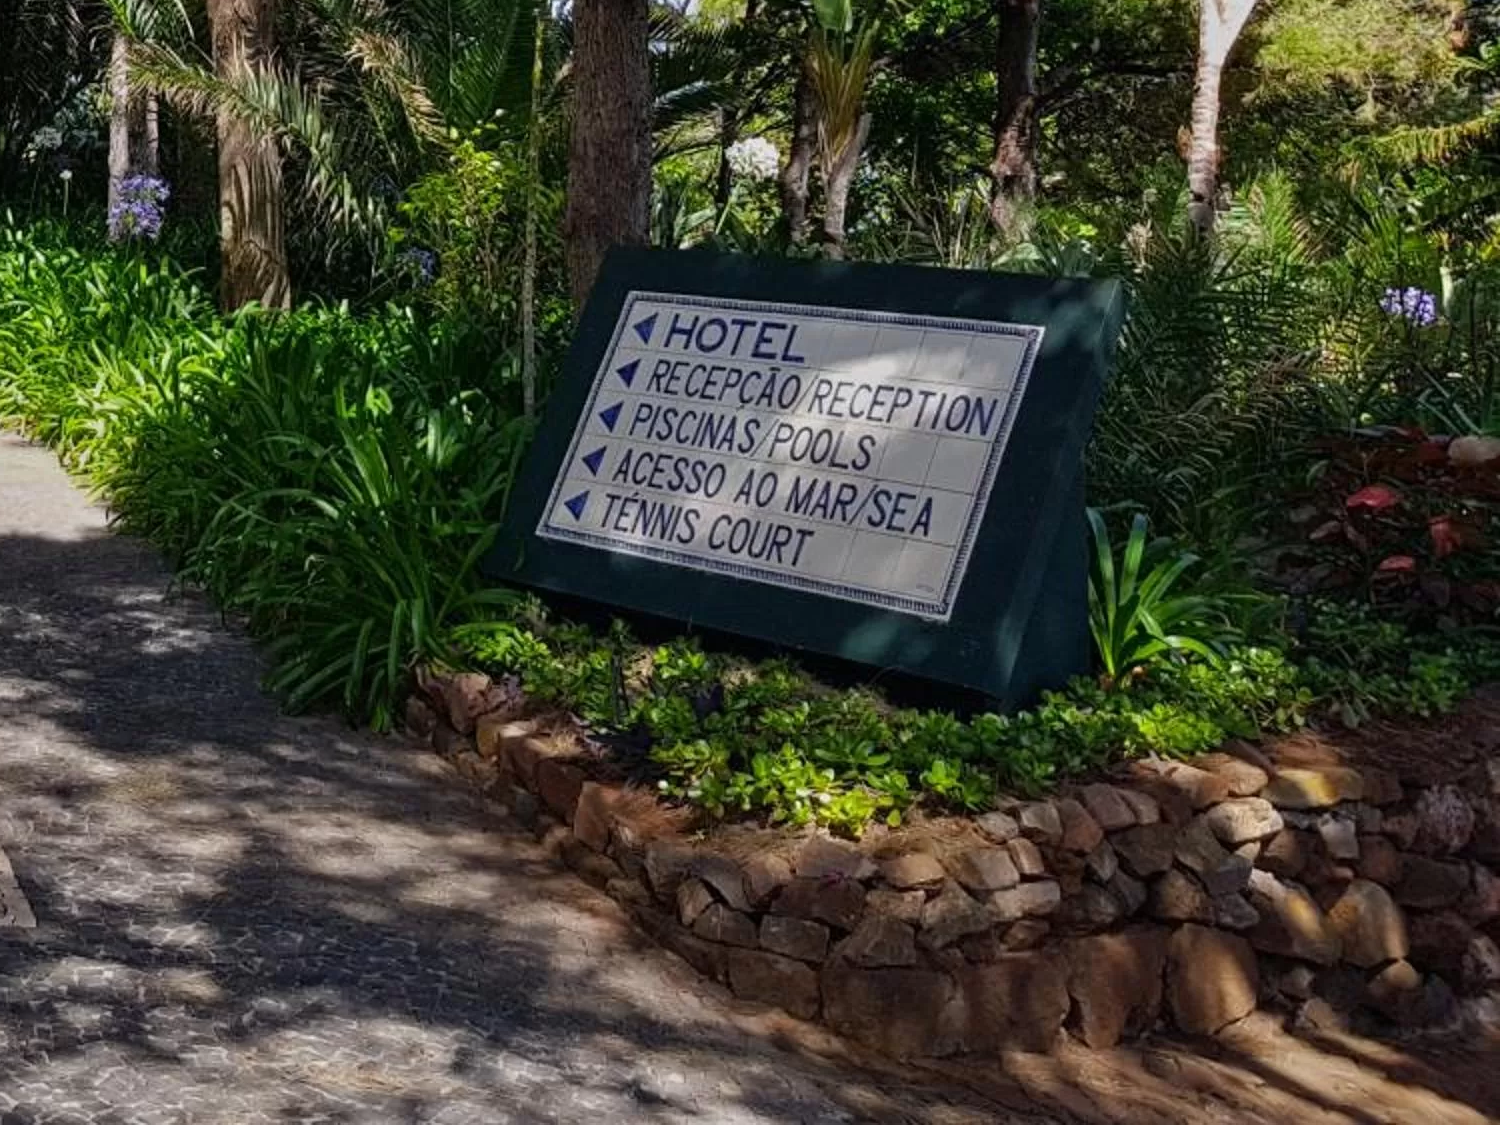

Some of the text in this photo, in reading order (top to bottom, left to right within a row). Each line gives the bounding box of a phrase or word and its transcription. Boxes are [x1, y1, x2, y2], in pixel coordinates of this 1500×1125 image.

[663, 314, 805, 364] HOTEL
[646, 359, 998, 435] RECEPÇÃO/RECEPTION
[629, 402, 876, 470] PISCINAS/POOLS
[611, 448, 933, 537] ACESSO AO MAR/SEA
[708, 514, 815, 566] COURT
